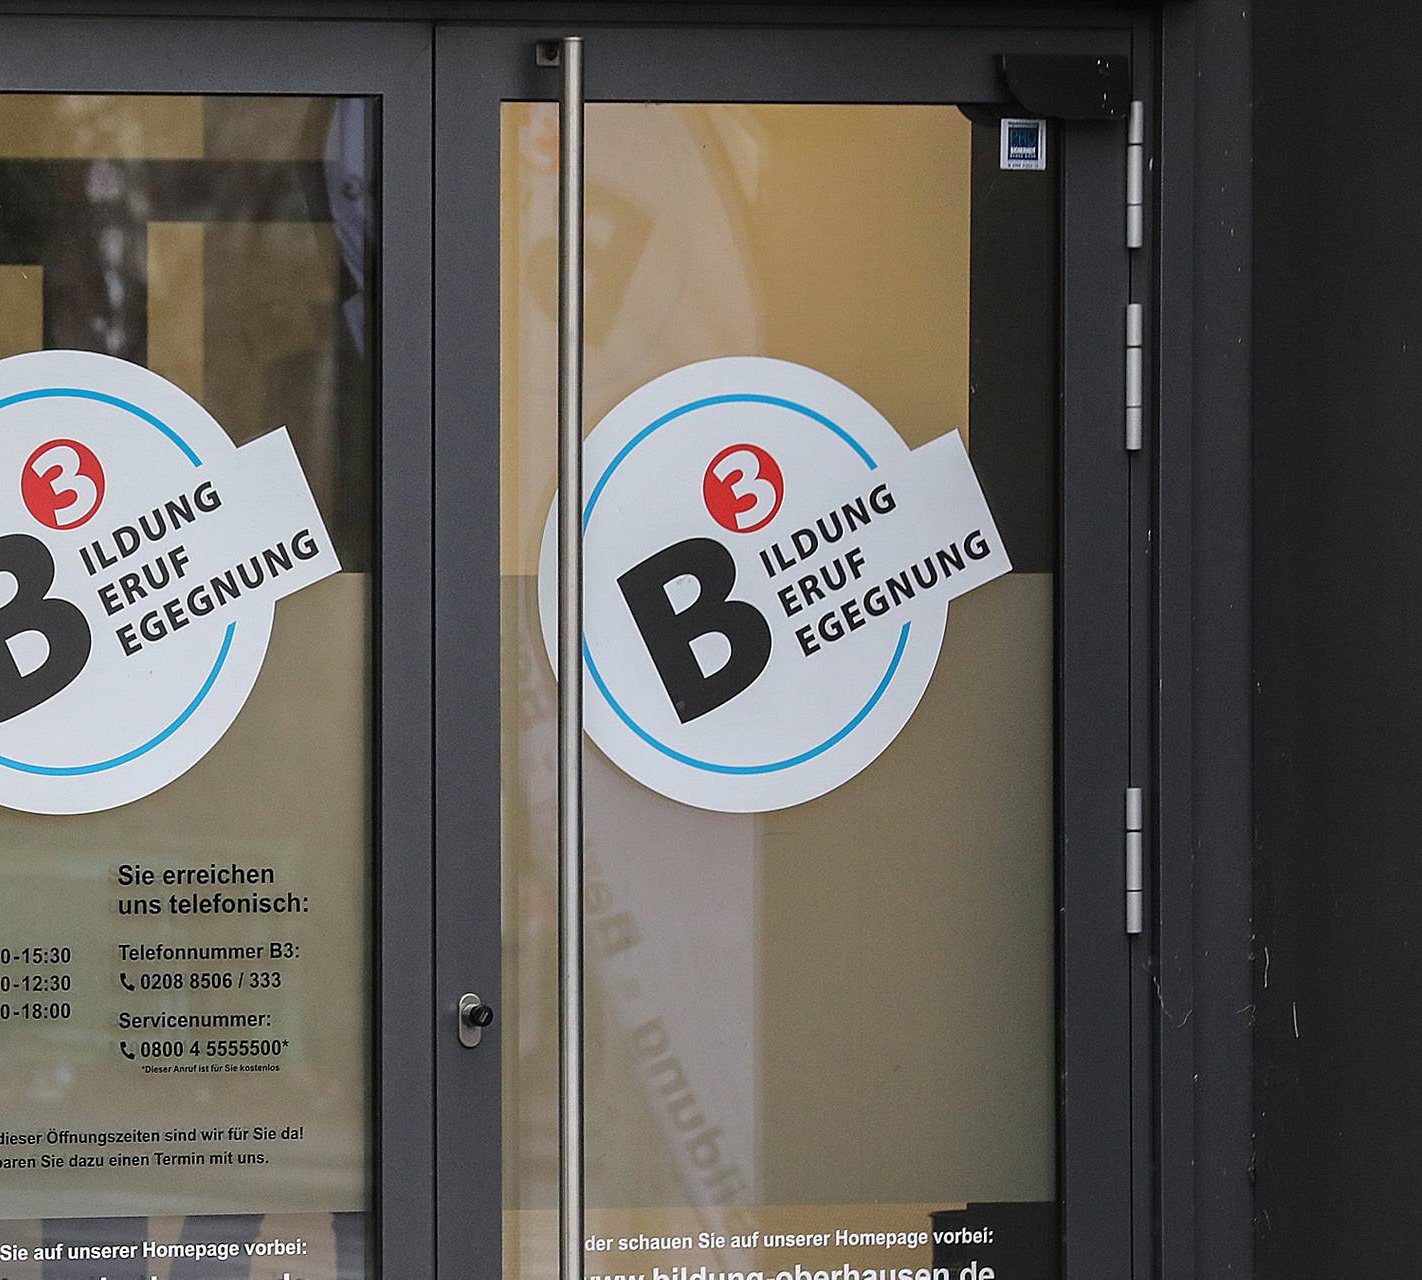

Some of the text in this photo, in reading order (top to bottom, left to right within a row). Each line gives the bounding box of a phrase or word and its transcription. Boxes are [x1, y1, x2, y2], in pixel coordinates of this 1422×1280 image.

[31, 445, 98, 527] 3
[712, 450, 777, 530] 3
[78, 481, 222, 576] ILDUNG
[759, 483, 898, 578] ILDUNG
[96, 545, 191, 616] ERUF
[115, 528, 320, 656] EGEGNUNG
[777, 547, 867, 618] ERUF
[794, 529, 991, 657] EGEGNUNG
[616, 537, 772, 724] B
[117, 864, 275, 885] Sie erreichen
[118, 894, 309, 914] uns telefonisch:
[118, 942, 300, 961] Telefonnummer B3:
[140, 971, 281, 991] 0208 8506 / 333
[118, 1011, 271, 1030] Servicenummer:
[140, 1041, 184, 1059] 0800
[190, 1041, 200, 1058] 4
[173, 1065, 197, 1073] Anruf
[199, 1065, 209, 1073] ist
[225, 1064, 238, 1072] Sie
[240, 1064, 280, 1072] kostenlos
[46, 1127, 160, 1147] Öffnungszeiten
[164, 1128, 197, 1143] sind
[201, 1127, 223, 1143] wir
[228, 1127, 248, 1142] für
[253, 1126, 277, 1141] Sie
[280, 1126, 303, 1141] da!
[41, 1154, 64, 1169] Sie
[68, 1153, 104, 1169] dazu
[109, 1153, 150, 1168] einen
[154, 1152, 205, 1167] Termin
[209, 1151, 233, 1165] mit
[237, 1150, 269, 1165] uns.
[0, 1244, 28, 1262] Sie
[33, 1243, 63, 1261] auf
[67, 1241, 137, 1260] unserer
[142, 1239, 240, 1260] Homepage
[245, 1238, 307, 1256] vorbei:
[584, 1228, 993, 1251] der schauen Sie auf unserer Homepage vorbei:
